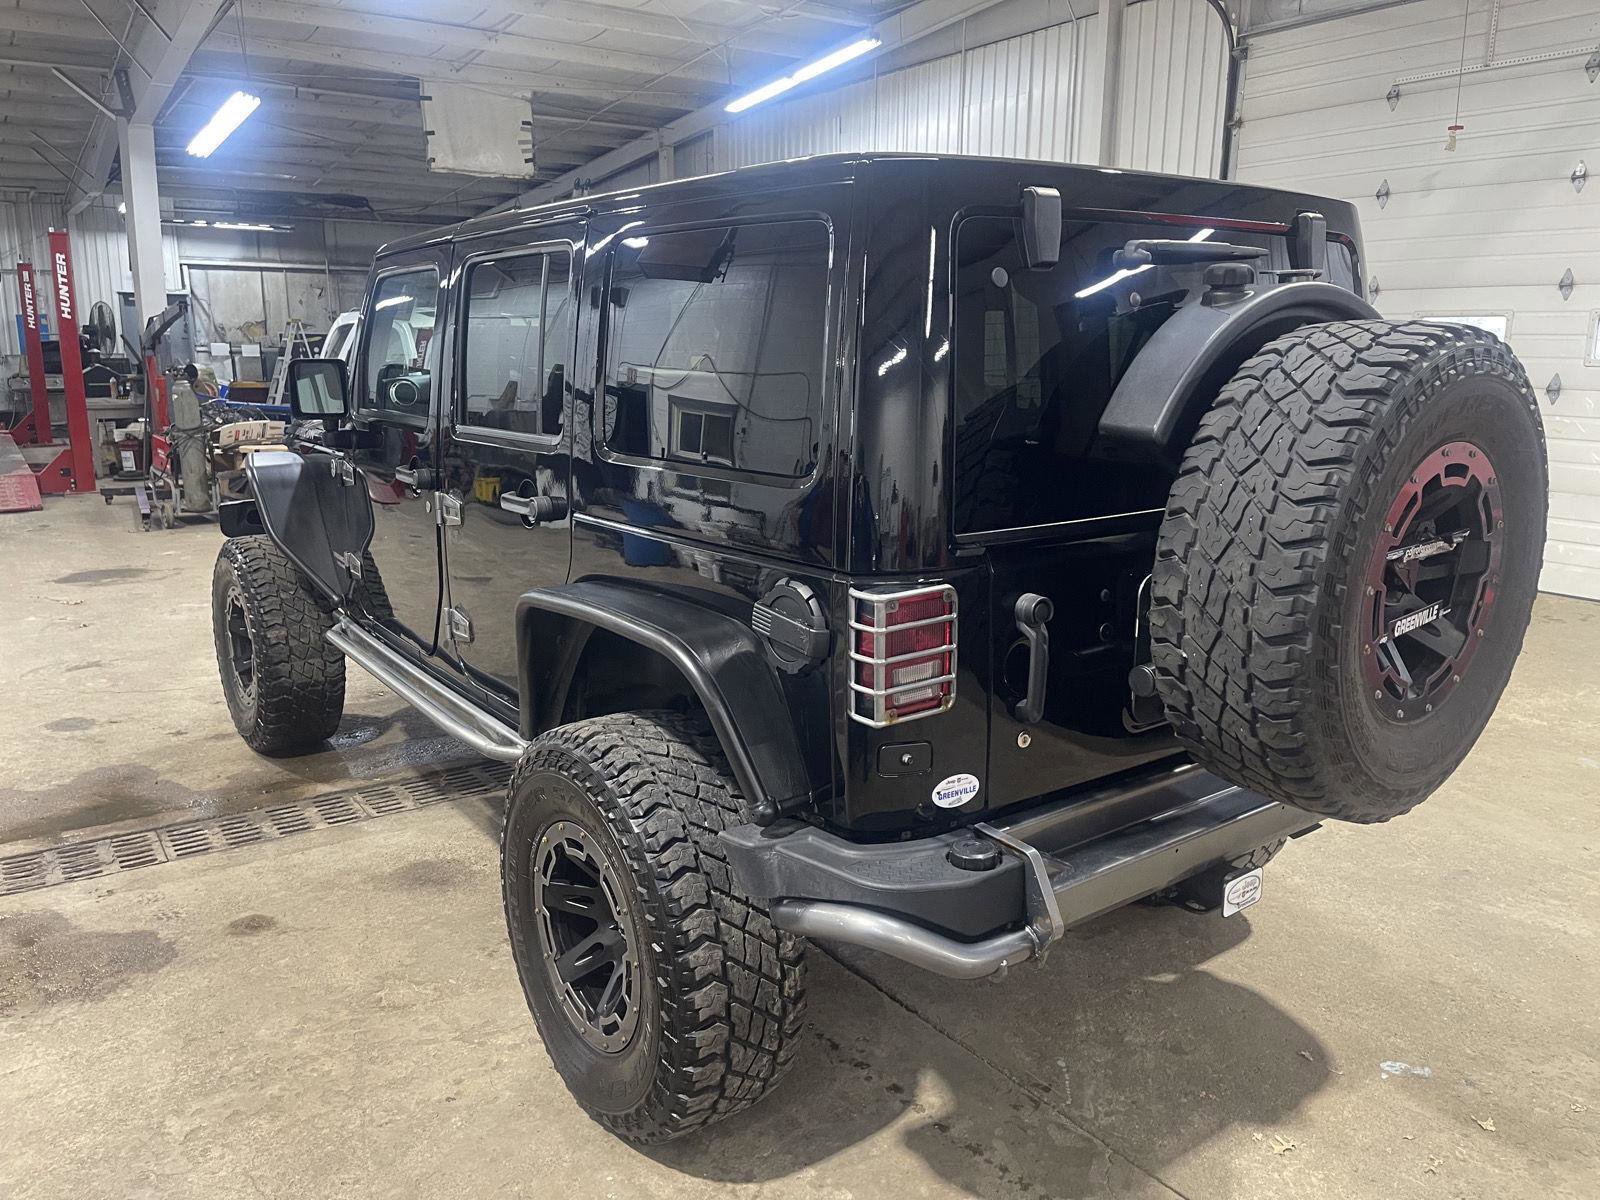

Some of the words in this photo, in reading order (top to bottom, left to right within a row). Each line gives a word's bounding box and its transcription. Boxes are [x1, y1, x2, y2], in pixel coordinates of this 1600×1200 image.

[24, 282, 36, 329] HUNTER
[55, 252, 72, 319] HUNTER
[1394, 604, 1439, 638] GREENVILLE
[937, 784, 977, 801] GREENVILLE
